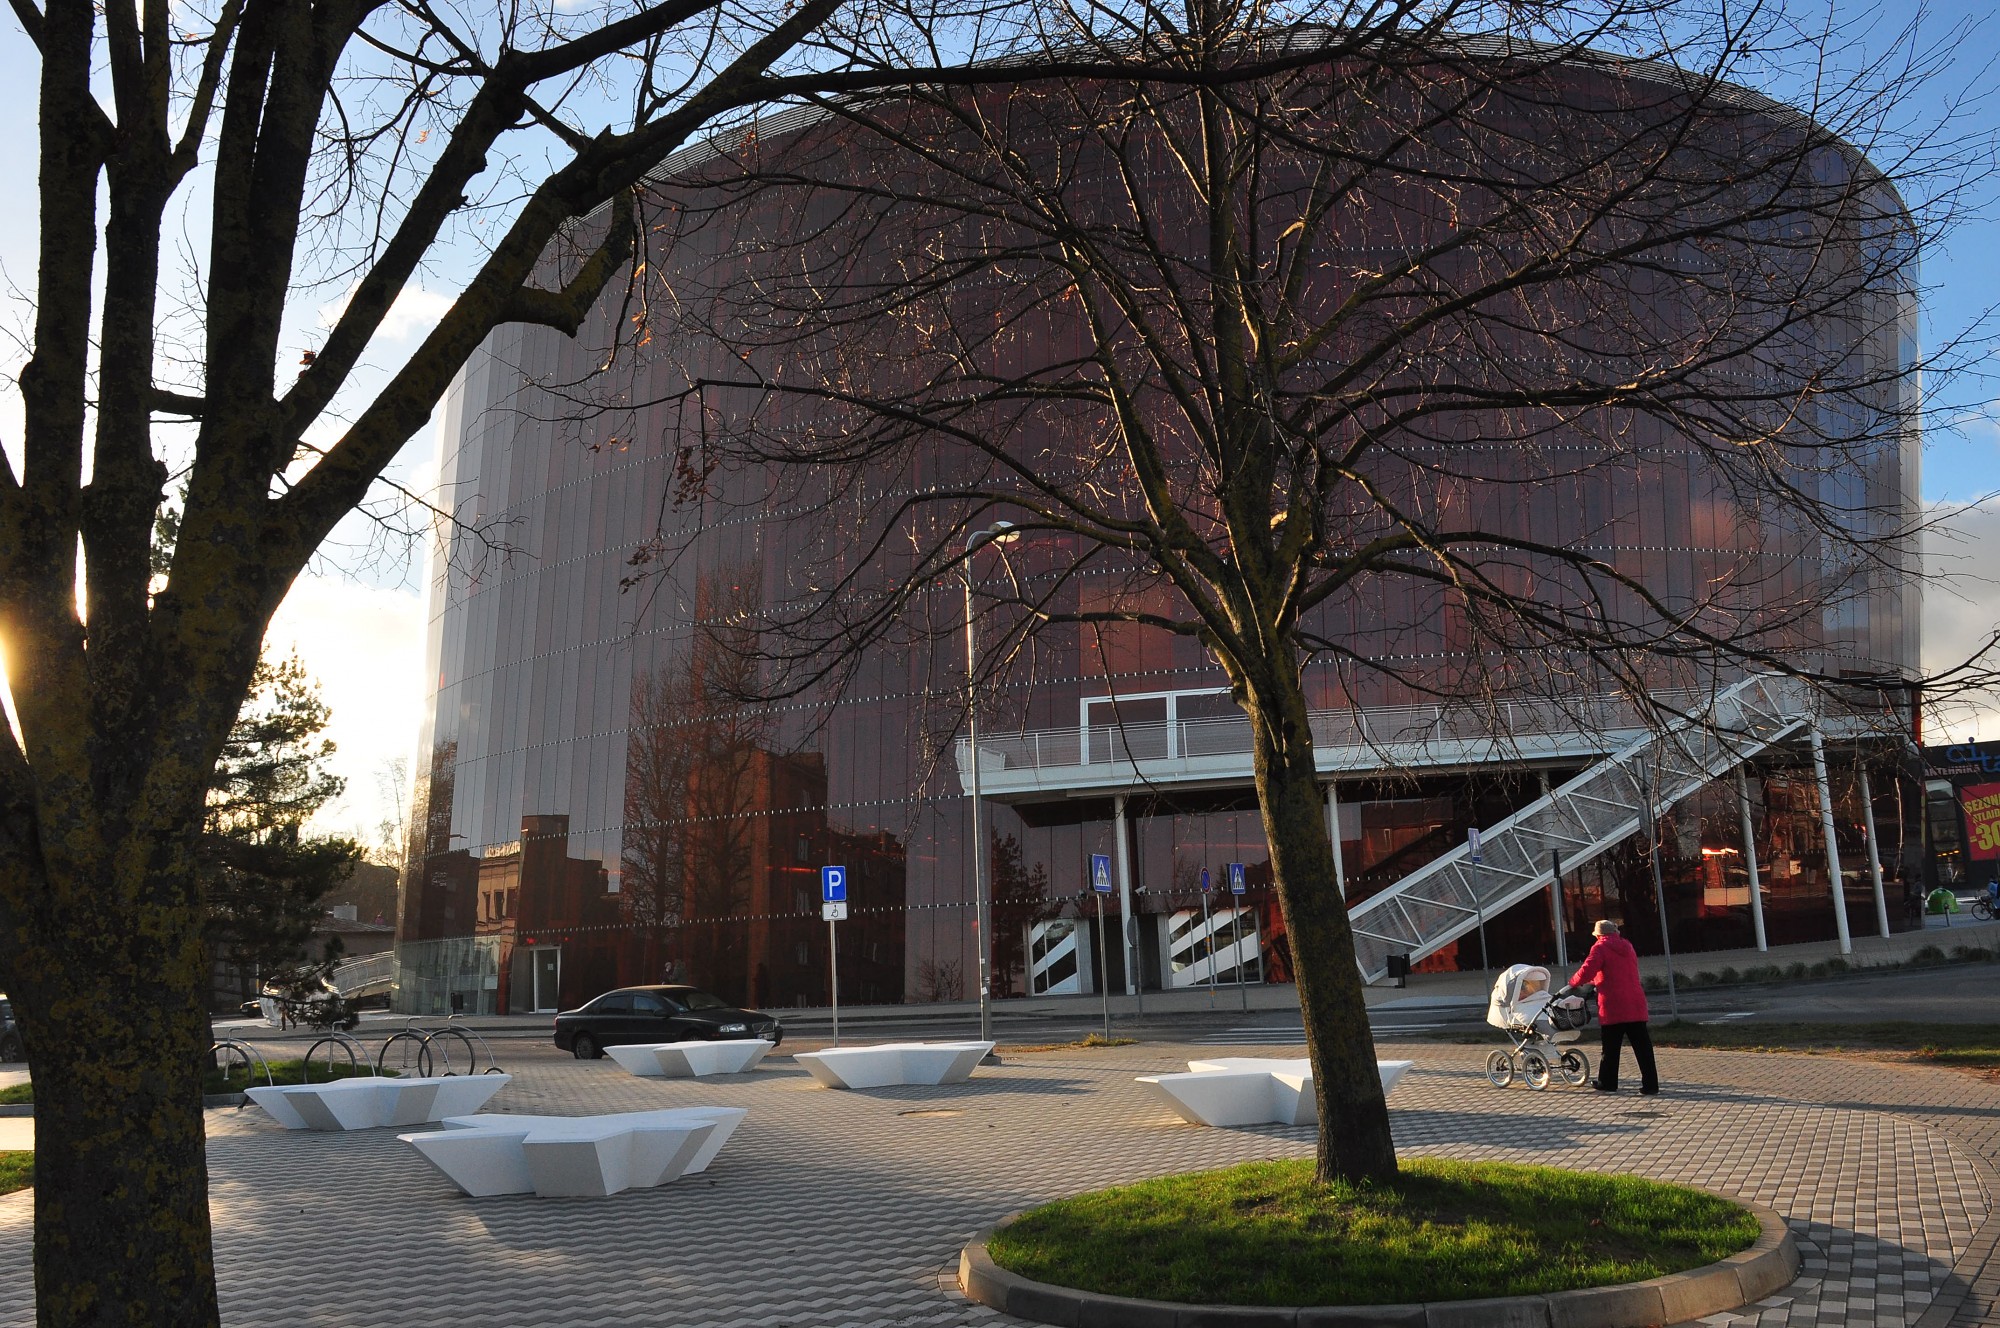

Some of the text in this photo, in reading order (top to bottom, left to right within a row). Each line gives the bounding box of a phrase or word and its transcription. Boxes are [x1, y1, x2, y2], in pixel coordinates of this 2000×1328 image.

[1964, 793, 2000, 812] SEZON
[1973, 808, 2000, 824] ATLAID
[828, 870, 842, 898] P
